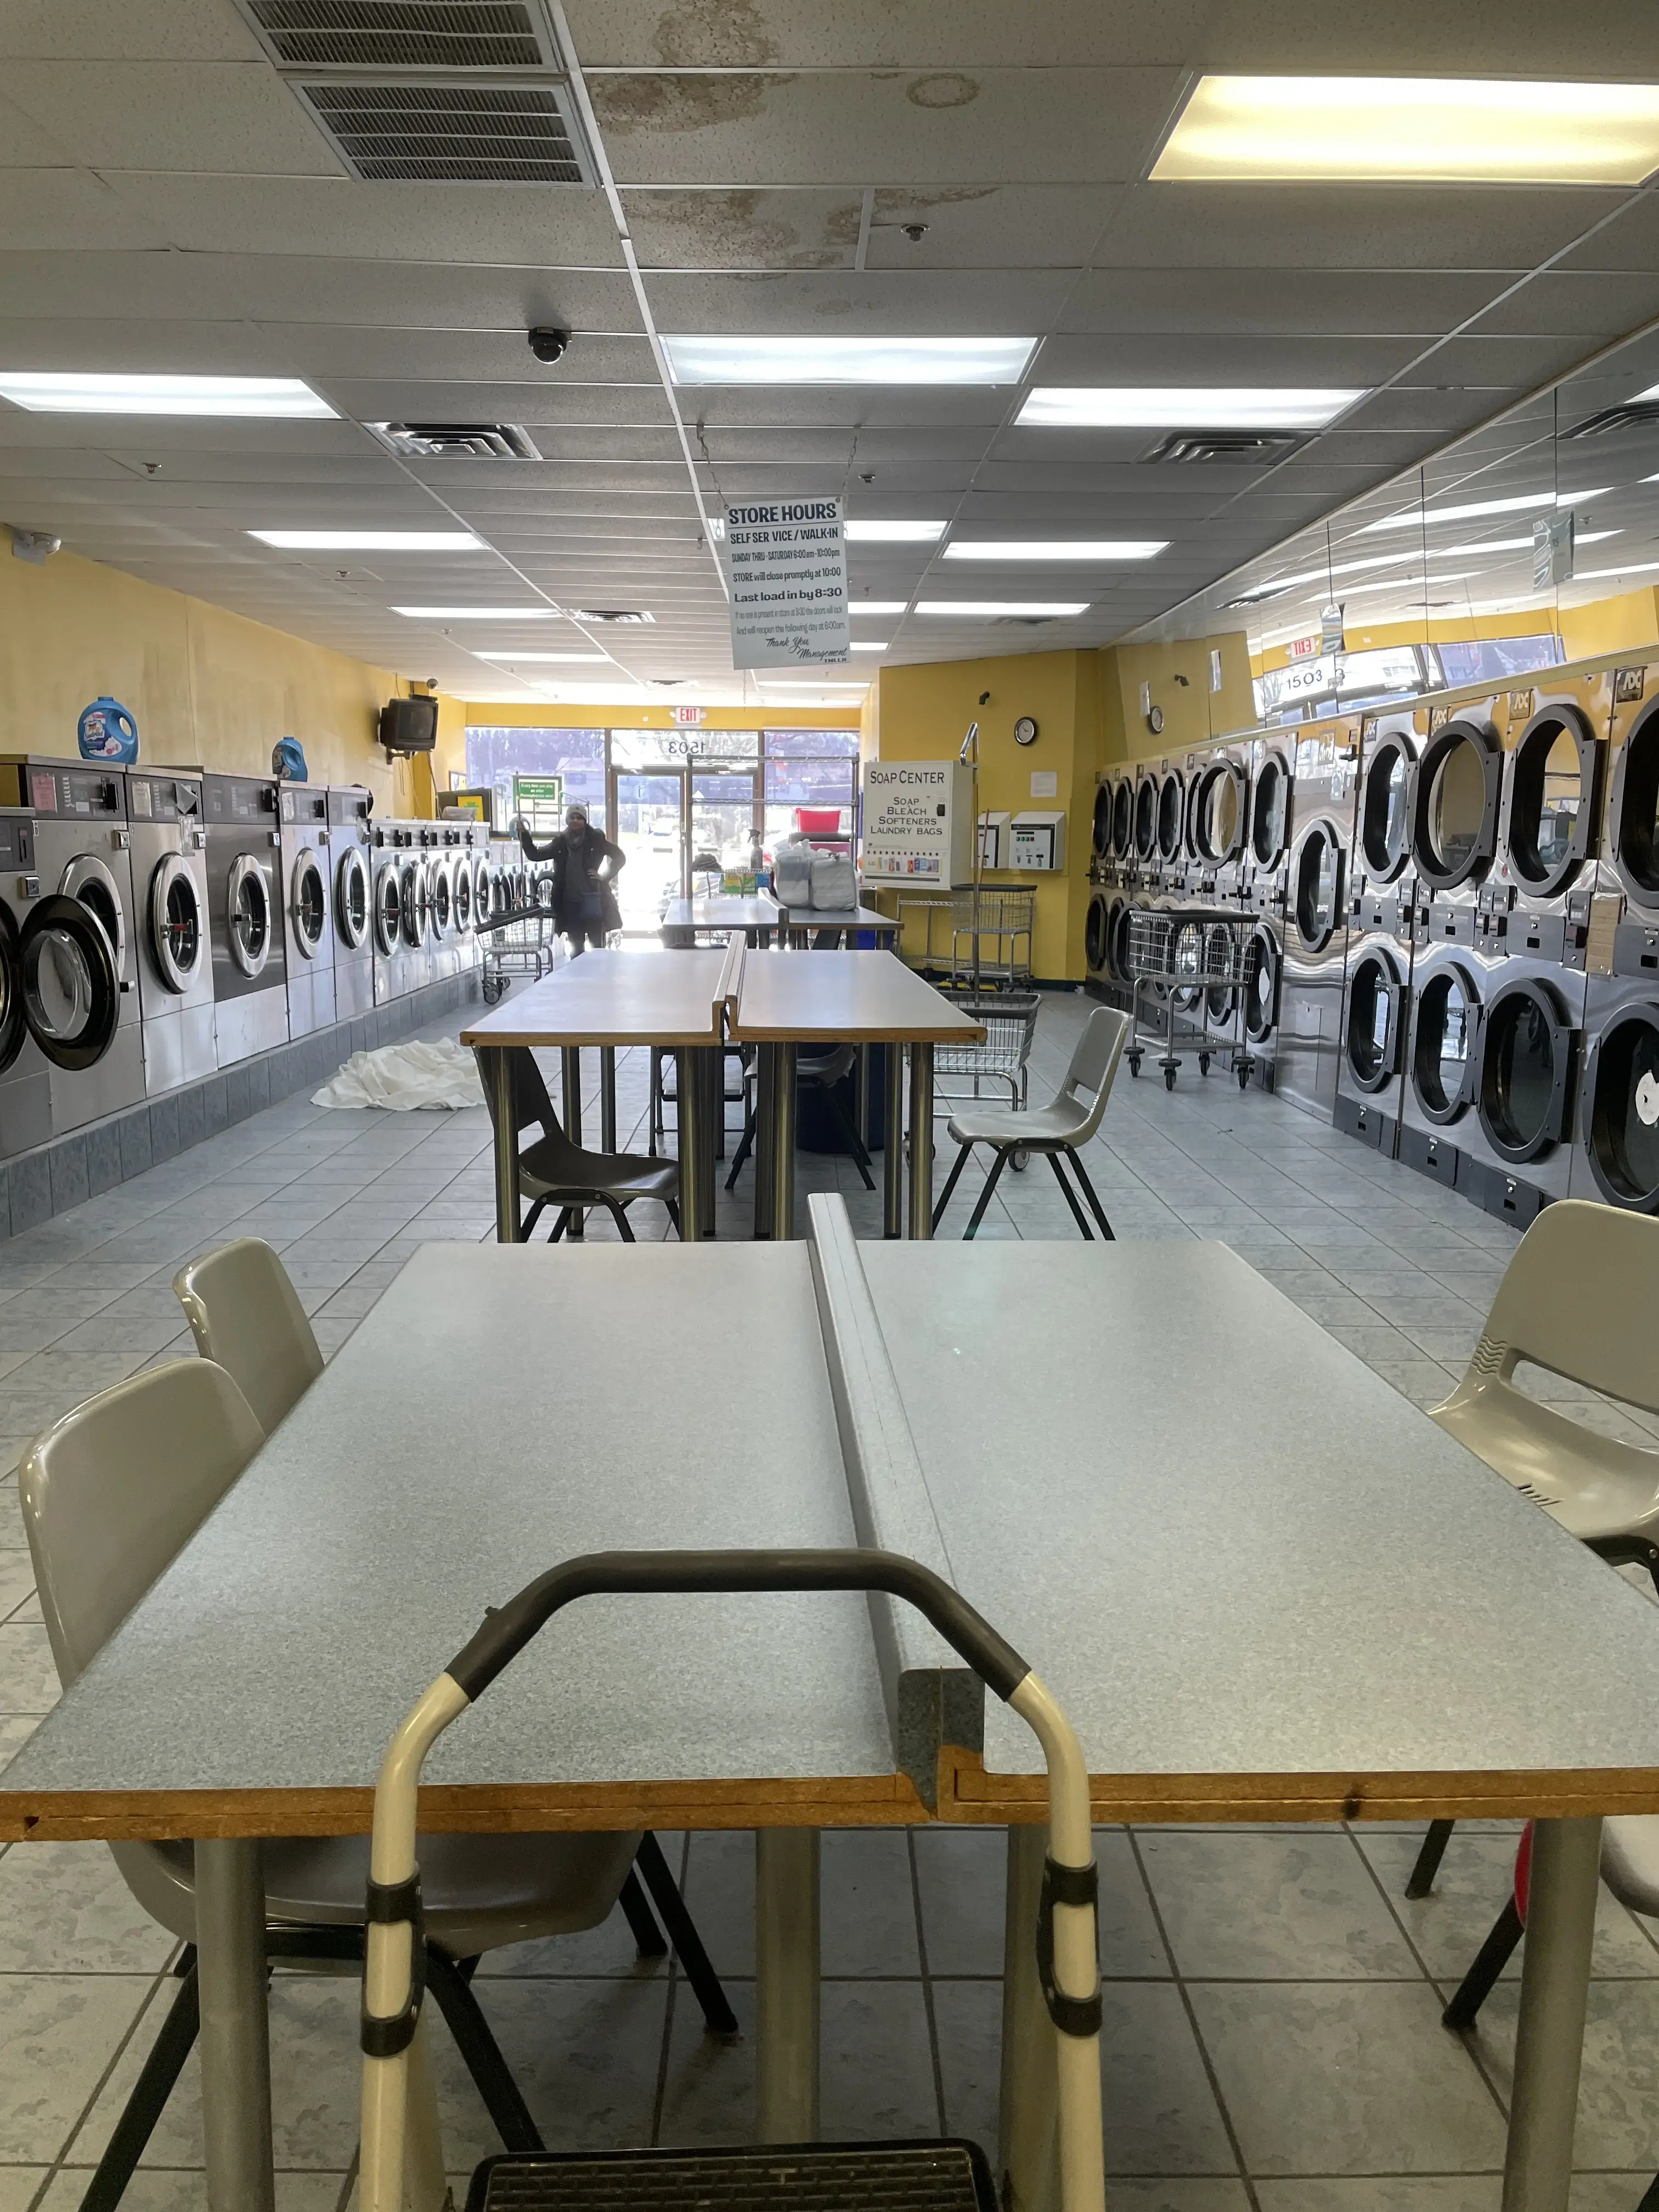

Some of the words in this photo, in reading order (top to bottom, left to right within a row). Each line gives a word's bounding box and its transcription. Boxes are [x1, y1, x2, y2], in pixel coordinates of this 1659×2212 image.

[728, 506, 779, 524] STORE
[781, 503, 837, 521] HOURS
[730, 533, 751, 544] SELF
[752, 532, 770, 543] SER
[800, 527, 838, 540] WALK-IN
[731, 552, 751, 563] SUNDAY
[752, 552, 765, 561] THRU
[768, 550, 793, 561] SATURDAY
[733, 572, 754, 583] STORE
[754, 572, 766, 581] will
[766, 571, 783, 580] close
[784, 569, 814, 582] promptly
[815, 569, 821, 578] at
[822, 567, 841, 577] 10:00
[734, 593, 759, 602] Last
[760, 591, 785, 601] load
[787, 590, 797, 600] in
[799, 590, 814, 601] by
[815, 587, 842, 598] 8:30
[736, 627, 747, 635] And
[747, 625, 756, 635] will
[756, 627, 775, 636] reopen
[775, 624, 785, 633] the
[785, 623, 808, 634] following
[808, 622, 817, 633] day
[765, 637, 789, 647] Thank
[797, 647, 847, 661] Management
[1286, 669, 1323, 690] 1503
[1623, 669, 1642, 691] ADC
[1514, 691, 1529, 710] ADC
[680, 708, 697, 721] EXIT
